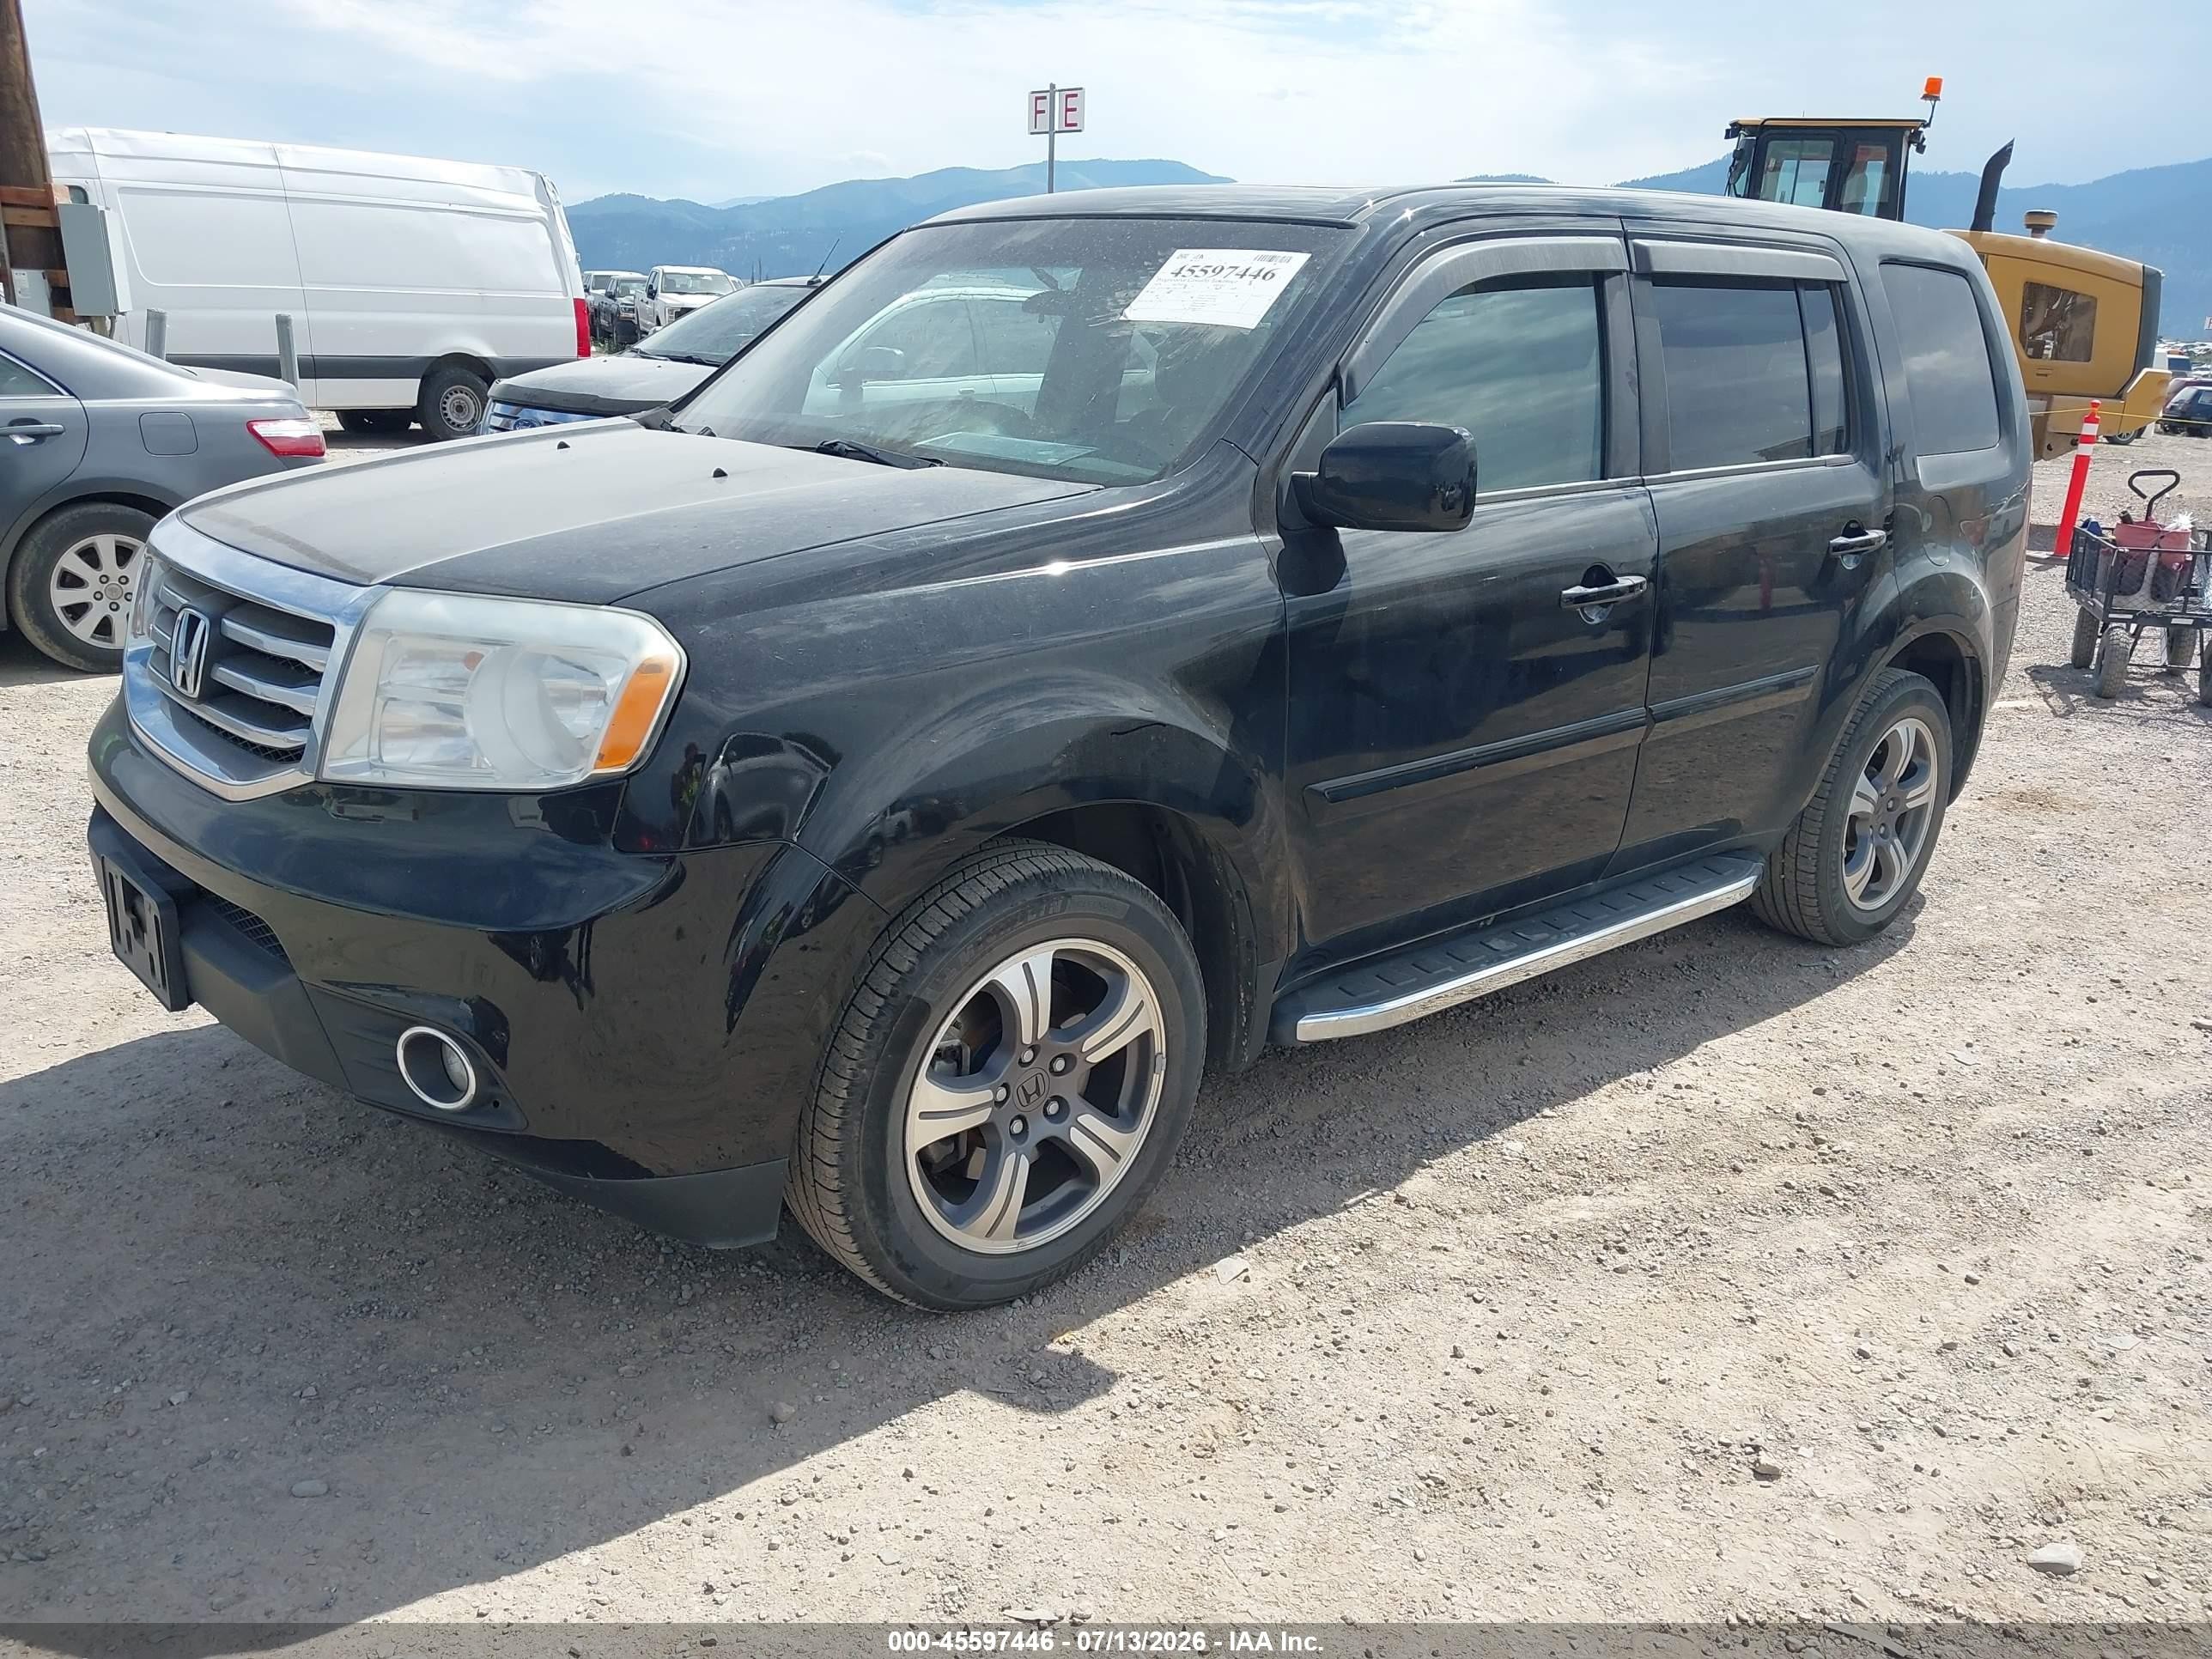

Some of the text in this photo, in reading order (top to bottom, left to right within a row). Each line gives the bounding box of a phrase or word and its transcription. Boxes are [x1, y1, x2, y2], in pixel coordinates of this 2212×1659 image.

[1034, 93, 1079, 130] F E
[1170, 263, 1280, 282] 45597446
